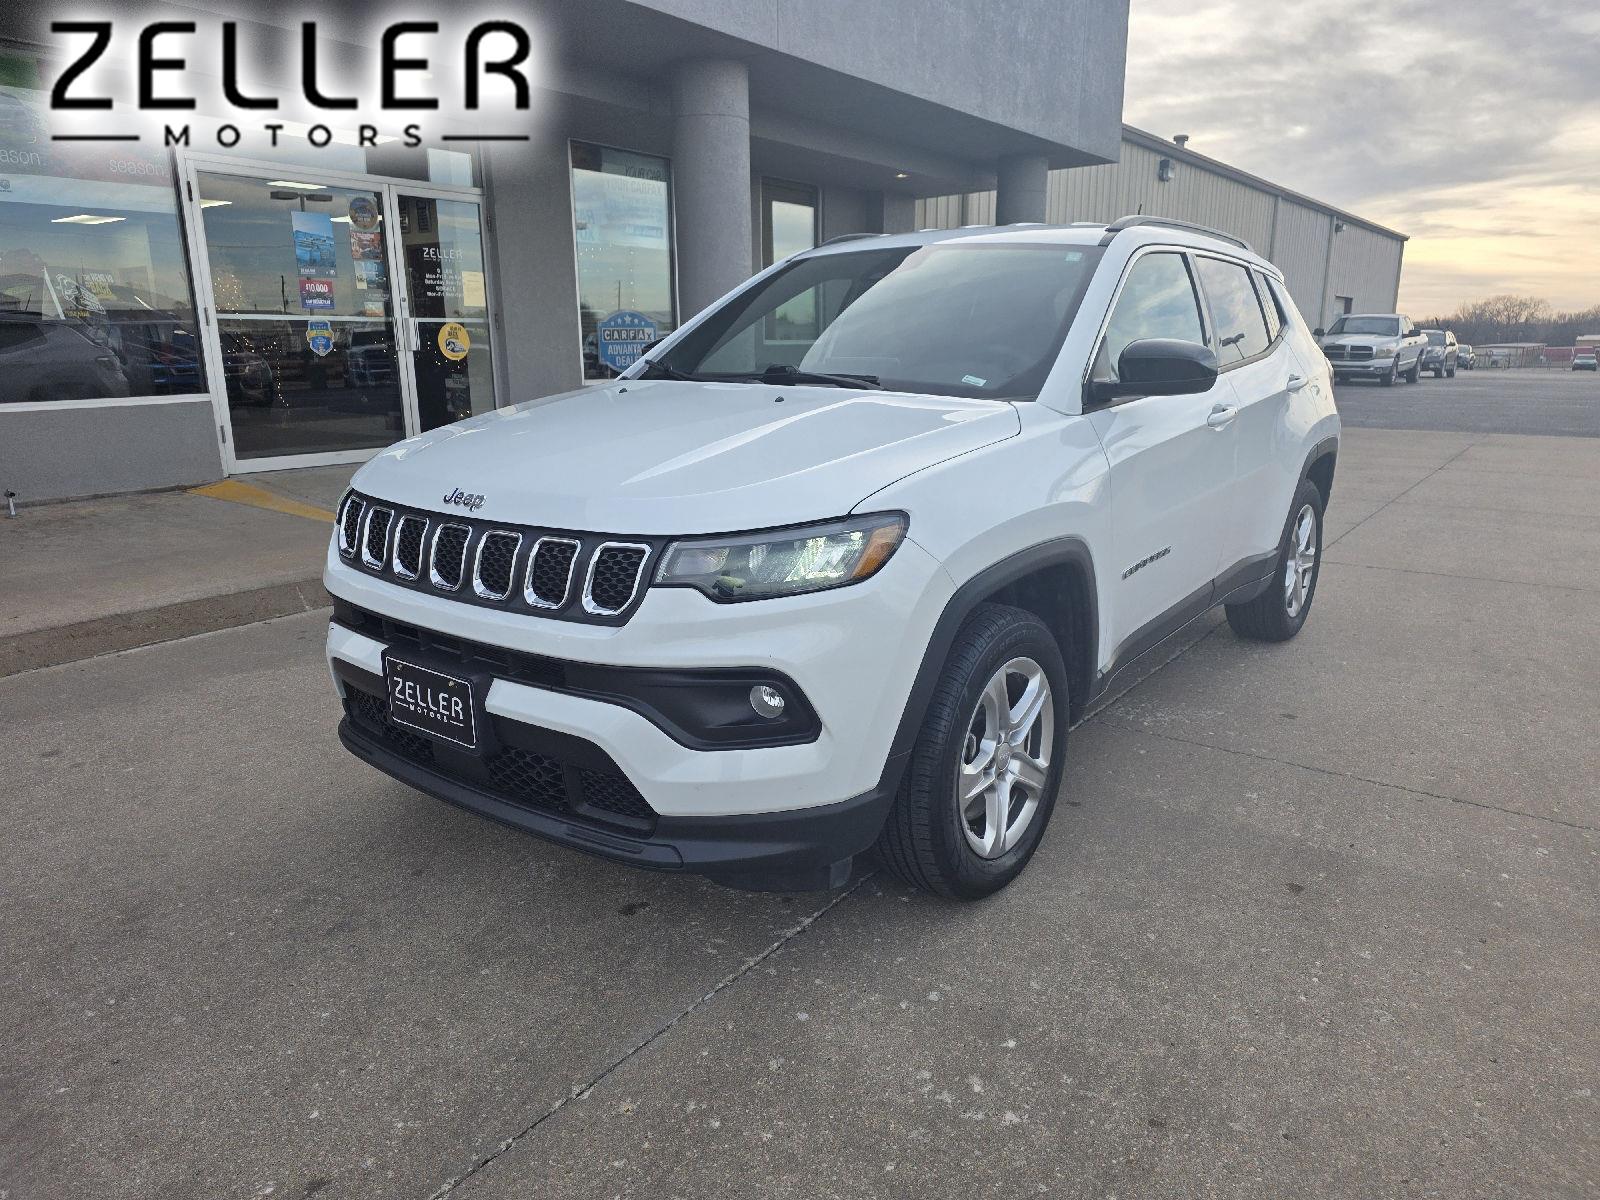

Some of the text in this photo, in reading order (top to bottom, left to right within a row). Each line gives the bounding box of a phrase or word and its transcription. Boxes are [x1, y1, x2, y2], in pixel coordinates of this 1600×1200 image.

[422, 247, 464, 260] ZELLER
[603, 329, 652, 341] CARFAX
[443, 487, 487, 512] Jeep
[393, 676, 464, 720] ZELLER
[409, 704, 448, 723] MOTORS
